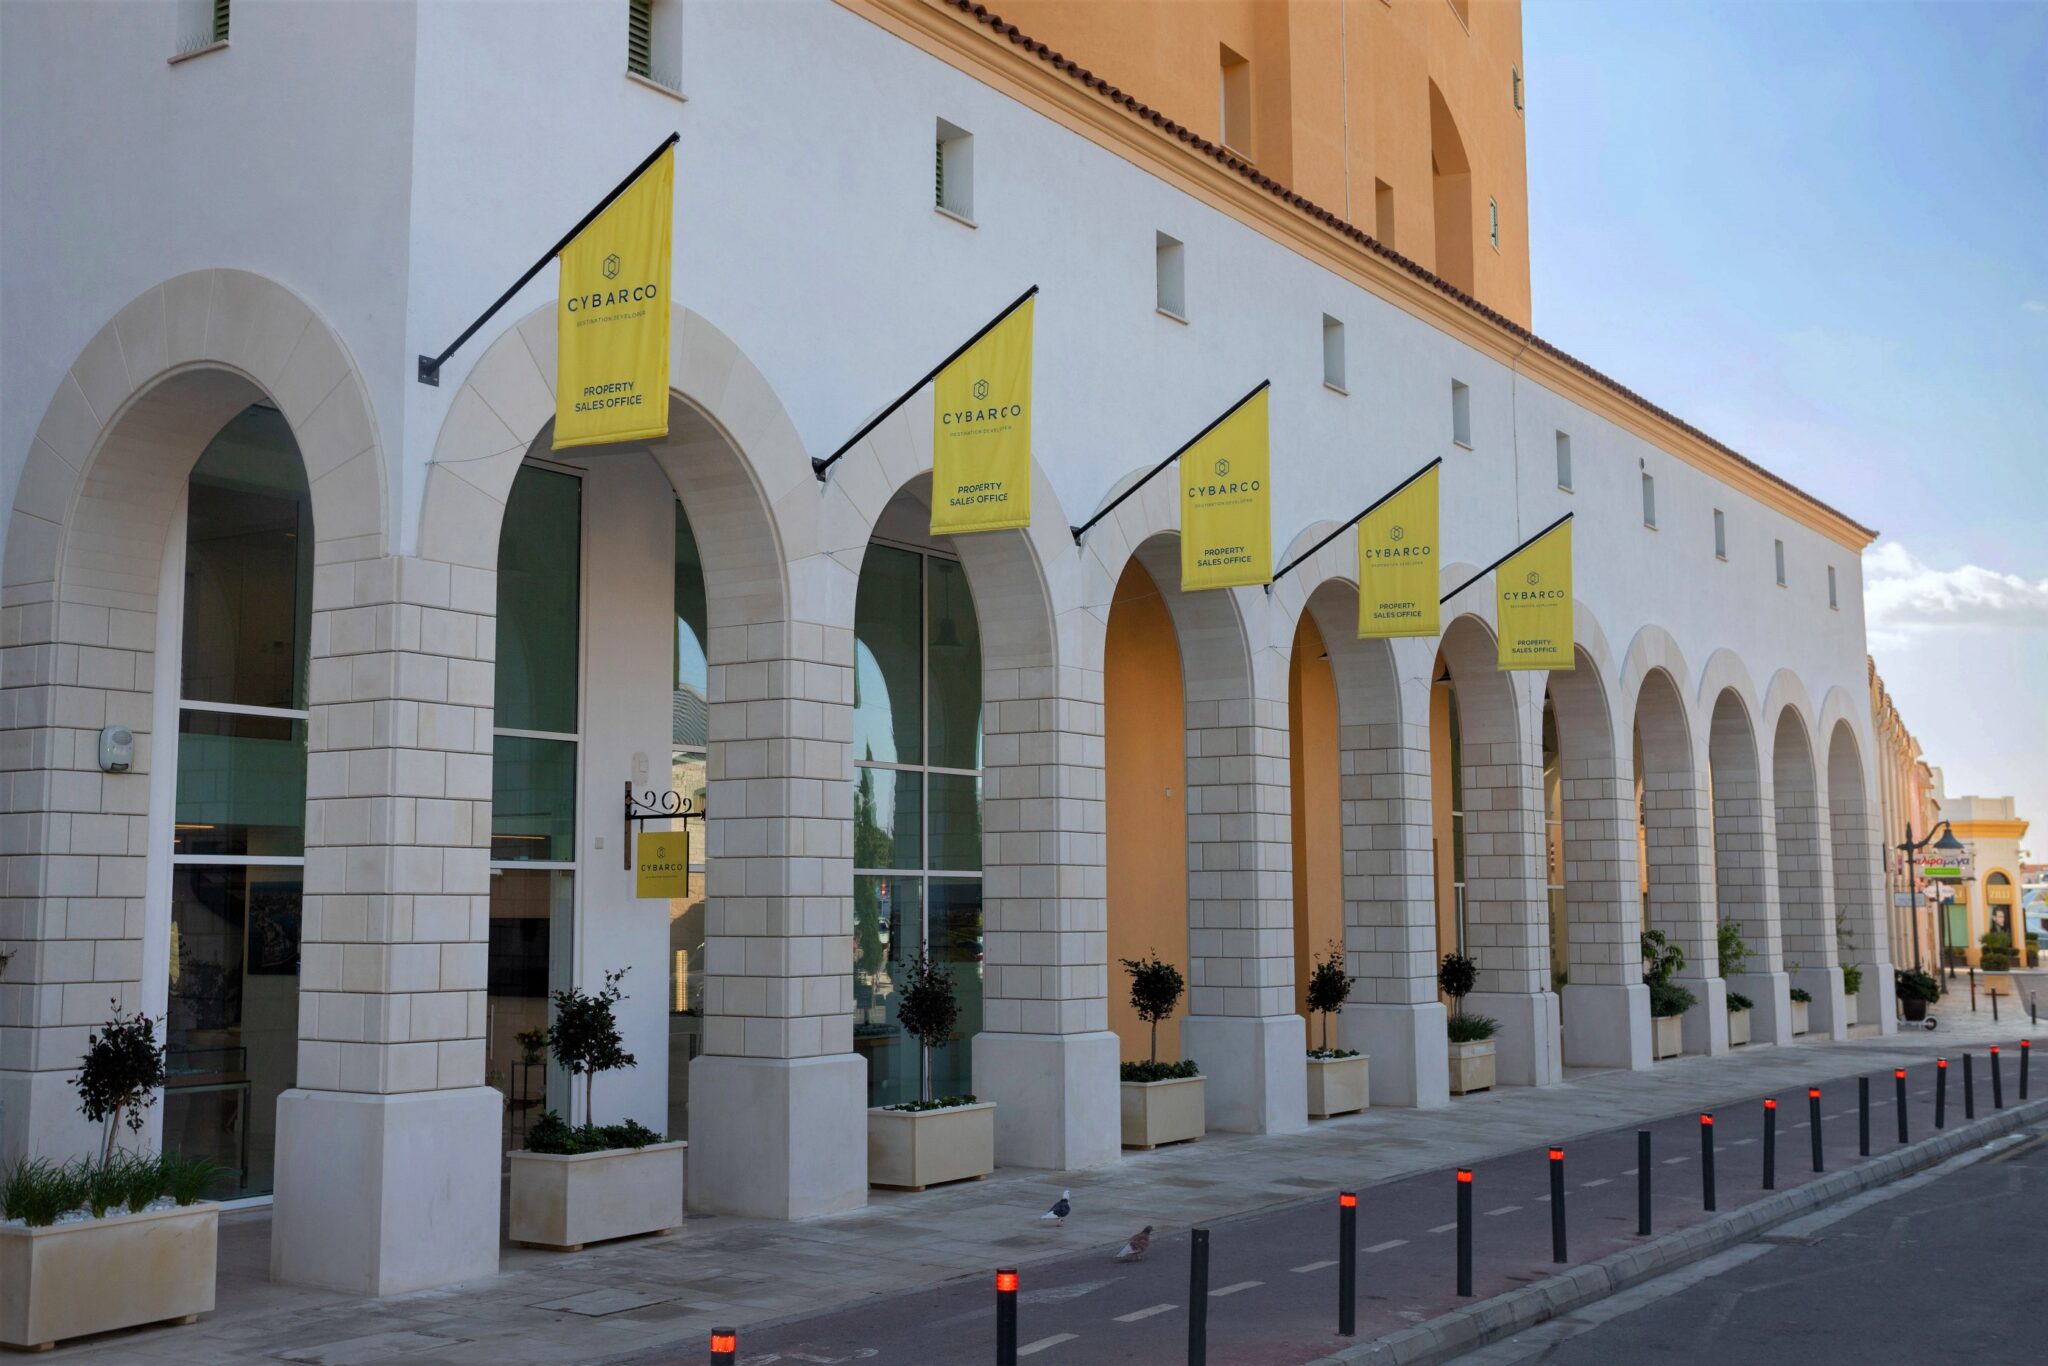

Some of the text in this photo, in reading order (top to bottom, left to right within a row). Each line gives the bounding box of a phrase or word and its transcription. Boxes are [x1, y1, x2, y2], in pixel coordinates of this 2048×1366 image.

[567, 284, 657, 312] CYBARCO
[584, 382, 634, 396] PROPERTY
[575, 394, 642, 412] SALES OFFICE
[942, 404, 1022, 425] CYBARCO
[958, 482, 1002, 494] PROPERTY
[1188, 480, 1260, 498] CYBARCO
[950, 492, 1008, 506] SALES OFFICE
[1204, 546, 1245, 556] PROPERTY
[1366, 546, 1431, 558] CYBARCO
[1197, 556, 1252, 567] SALES OFFICE
[1503, 590, 1565, 600] CYBARCO
[1379, 601, 1416, 610] PROPERTY
[641, 864, 683, 872] CYBARCO
